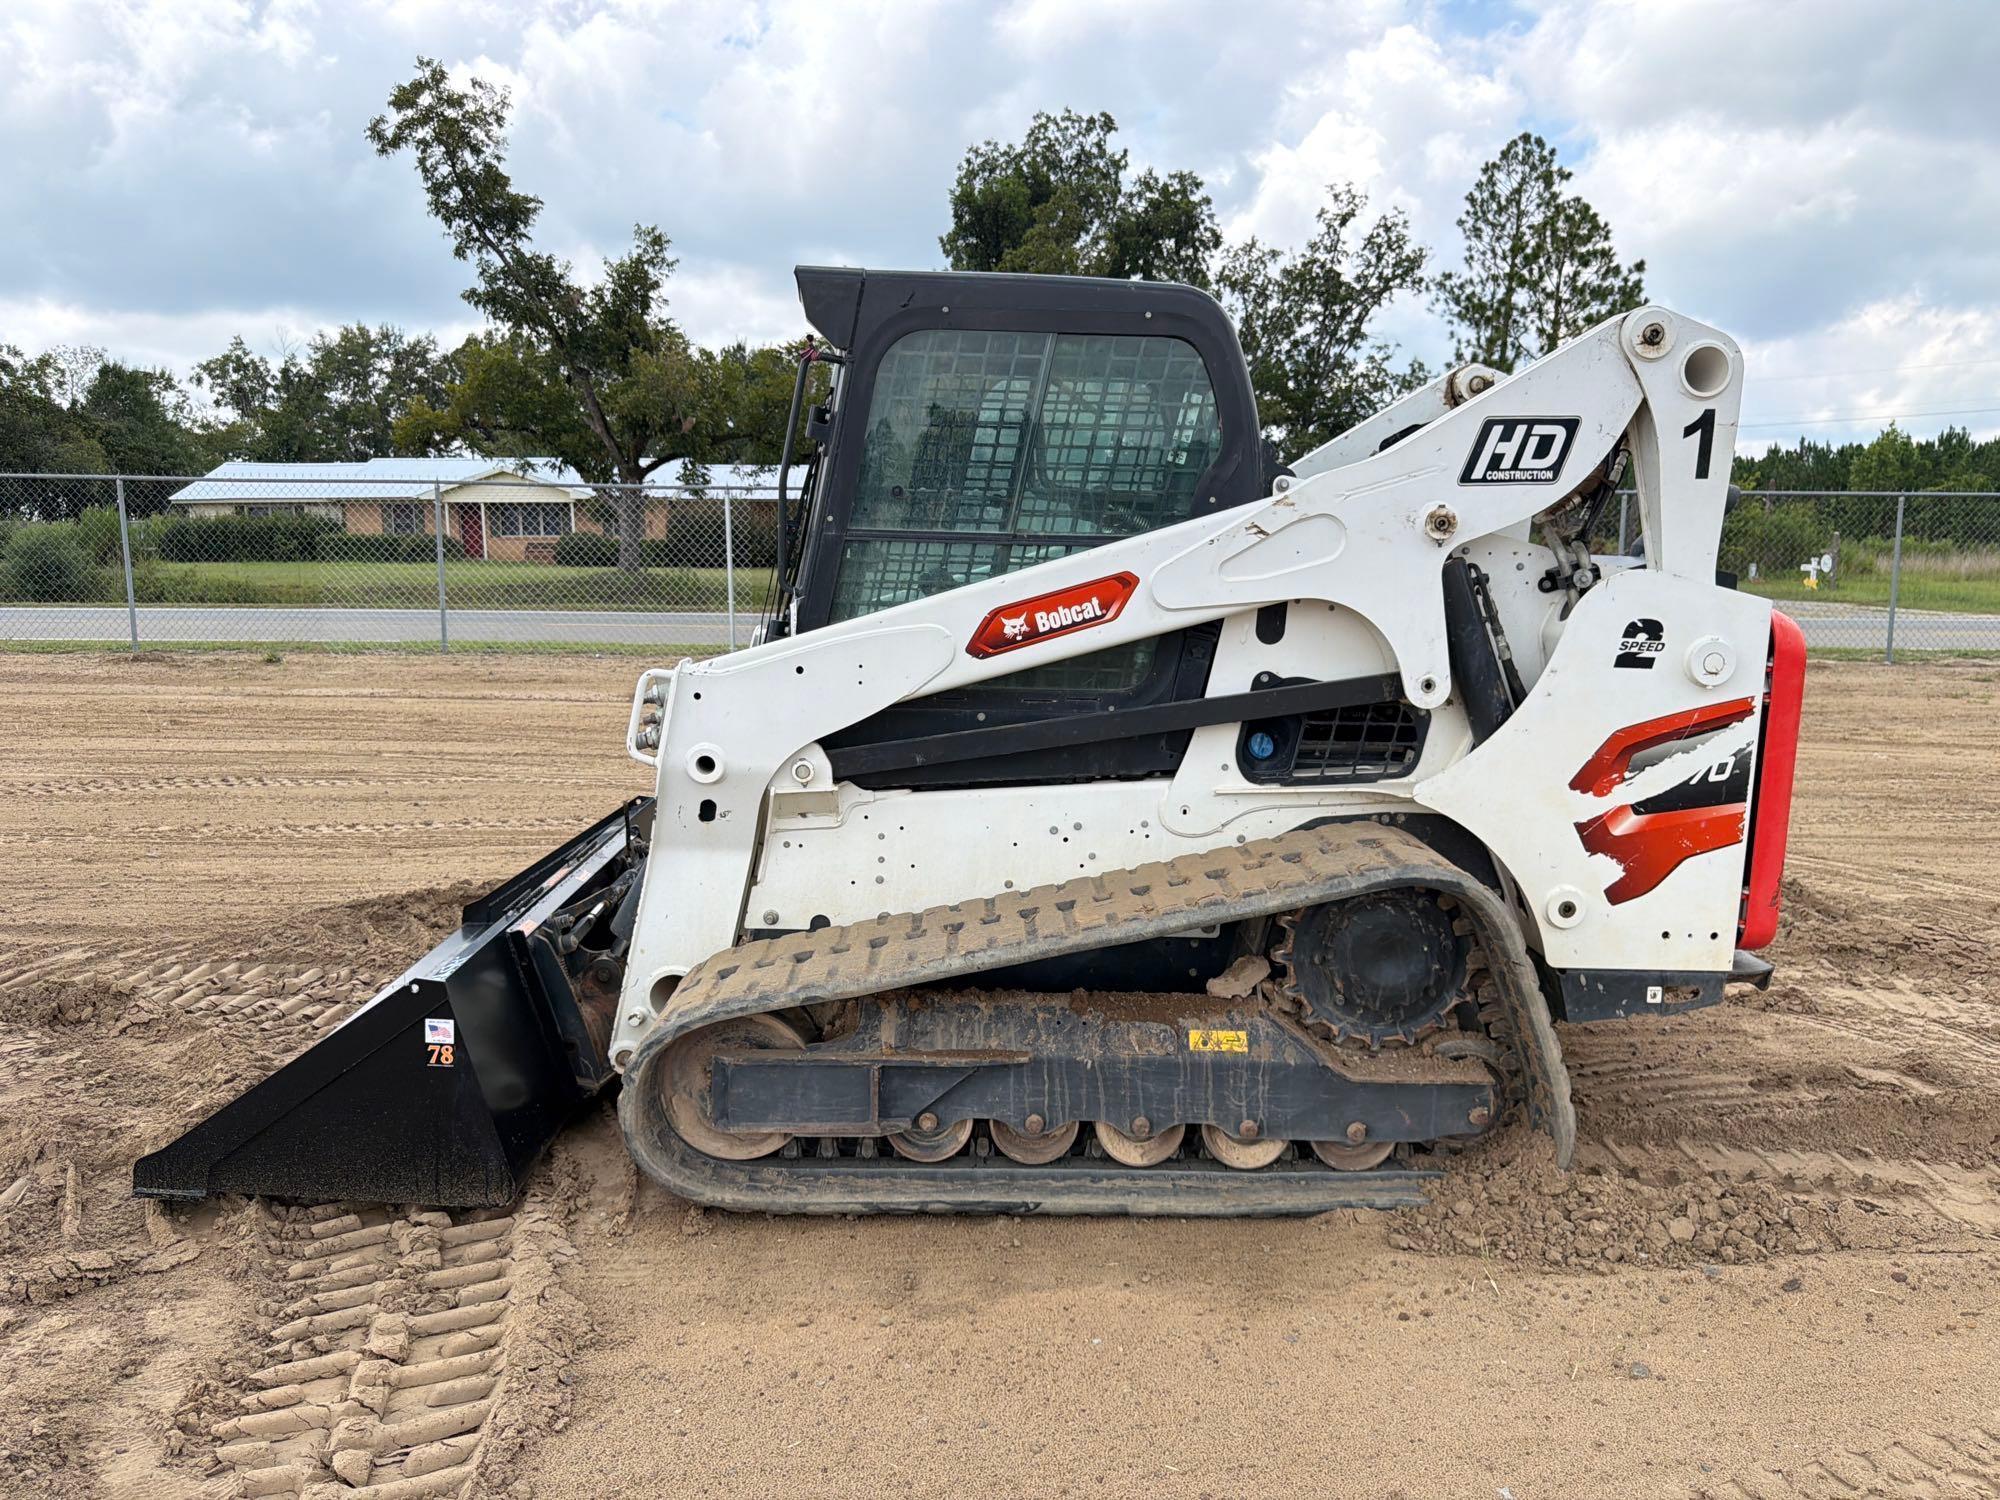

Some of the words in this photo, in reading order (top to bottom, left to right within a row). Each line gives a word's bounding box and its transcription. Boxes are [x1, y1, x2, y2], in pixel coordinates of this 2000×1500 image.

[1470, 424, 1567, 480] HD
[1683, 409, 1716, 479] 1
[1486, 470, 1554, 480] CONSTRUCTION
[1035, 597, 1104, 633] Bobcat
[1613, 618, 1665, 669] 2
[1618, 640, 1666, 652] SPEED
[427, 1045, 454, 1065] 78
